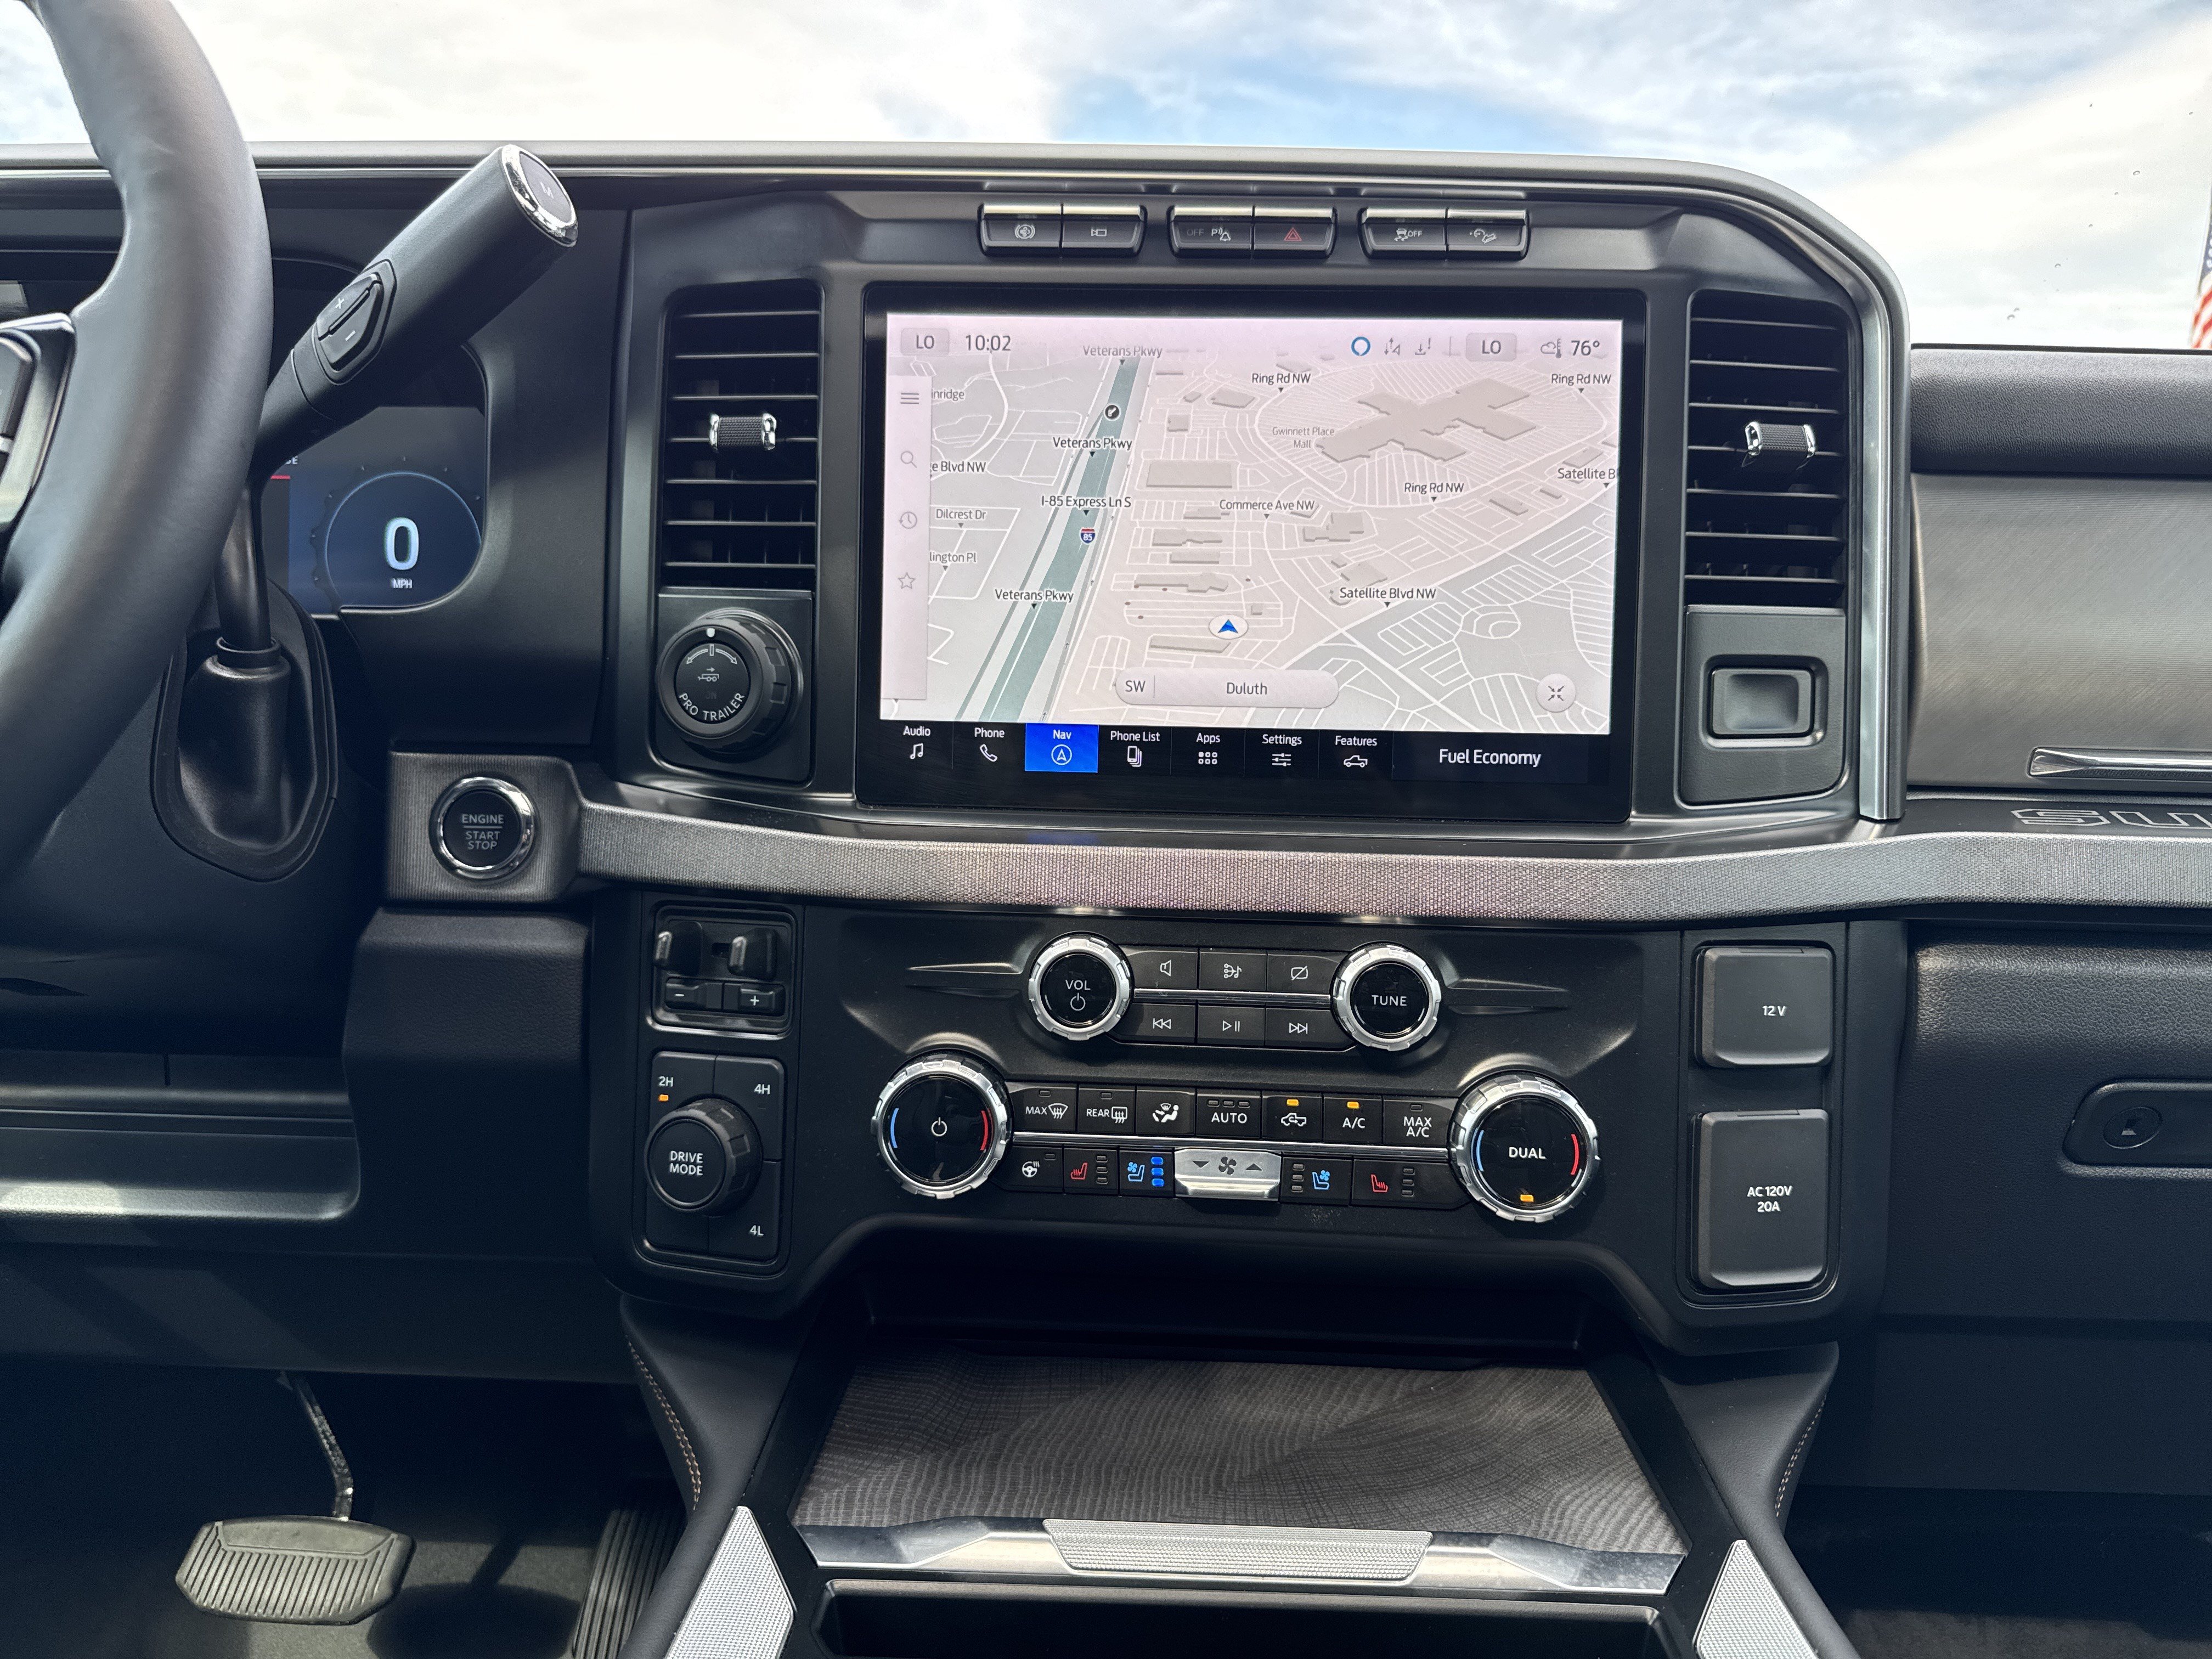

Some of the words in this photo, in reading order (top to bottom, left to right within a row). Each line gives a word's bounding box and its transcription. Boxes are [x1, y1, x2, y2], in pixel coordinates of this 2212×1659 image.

[1186, 228, 1204, 236] OFF
[916, 335, 935, 349] LO
[966, 335, 1011, 351] 10:02
[1482, 340, 1502, 354] LO
[1571, 340, 1600, 356] 76°
[1082, 345, 1131, 357] Veterans
[1133, 346, 1163, 358] Pkwy
[1252, 373, 1274, 385] Ring
[1277, 373, 1290, 384] Rd
[1292, 373, 1311, 384] NW
[1551, 374, 1574, 385] Ring
[1576, 374, 1589, 385] Rd
[1592, 374, 1611, 385] NW
[1272, 427, 1310, 437] Gwinnett
[1312, 427, 1335, 437] Place
[1053, 437, 1101, 450] Veterans
[1103, 438, 1133, 451] Pkwy
[1293, 439, 1311, 449] Mall
[941, 461, 964, 472] Blvd
[967, 461, 986, 472] NW
[1558, 467, 1605, 479] Satellite
[1404, 482, 1426, 494] Ring
[1429, 482, 1442, 493] Rd
[1444, 482, 1464, 493] NW
[1042, 496, 1063, 507] I-85
[1066, 496, 1107, 510] Express
[1109, 496, 1121, 507] Ln
[1125, 496, 1132, 507] S
[1220, 500, 1272, 511] Commerce
[1274, 500, 1295, 511] Ave
[1296, 500, 1314, 511] NW
[936, 509, 973, 520] Dilcrest
[975, 510, 986, 520] Dr
[385, 517, 420, 571] 0
[967, 552, 977, 562] Pl
[392, 578, 413, 589] MPH
[995, 589, 1042, 601] Veterans
[1045, 590, 1074, 603] Pkwy
[1339, 586, 1387, 599] Satellite
[1389, 587, 1414, 599] Blvd
[1417, 588, 1437, 599] NW
[1125, 680, 1146, 692] SW
[1227, 682, 1267, 695] Duluth
[679, 693, 698, 715] PRO
[703, 693, 745, 721] TRAILER
[903, 726, 931, 737] Audio
[974, 727, 1005, 738] Phone
[1053, 729, 1071, 740] Nav
[1110, 731, 1140, 742] Phone
[1142, 731, 1160, 742] List
[1196, 733, 1221, 744] Apps
[1262, 734, 1302, 747] Settings
[1335, 735, 1378, 747] Features
[1439, 749, 1470, 764] Fuel
[1474, 749, 1542, 768] Economy
[461, 814, 504, 825] ENGINE
[465, 831, 500, 840] START
[467, 841, 498, 850] STOP
[1065, 979, 1091, 991] VOL
[1372, 994, 1407, 1007] TUNE
[658, 1076, 674, 1087] 2H
[754, 1084, 770, 1095] 4H
[1025, 1105, 1047, 1115] MAX
[1086, 1108, 1110, 1118] REAR
[1211, 1113, 1248, 1124] AUTO
[1342, 1118, 1365, 1130] A/C
[1403, 1116, 1432, 1128] MAX
[1406, 1126, 1430, 1138] A/C
[670, 1150, 704, 1164] DRIVE
[1509, 1147, 1546, 1160] DUAL
[669, 1163, 703, 1176] MODE
[1747, 1186, 1763, 1198] AC
[1765, 1185, 1793, 1197] 120V
[1757, 1201, 1781, 1213] 20A
[749, 1225, 764, 1237] 4L
